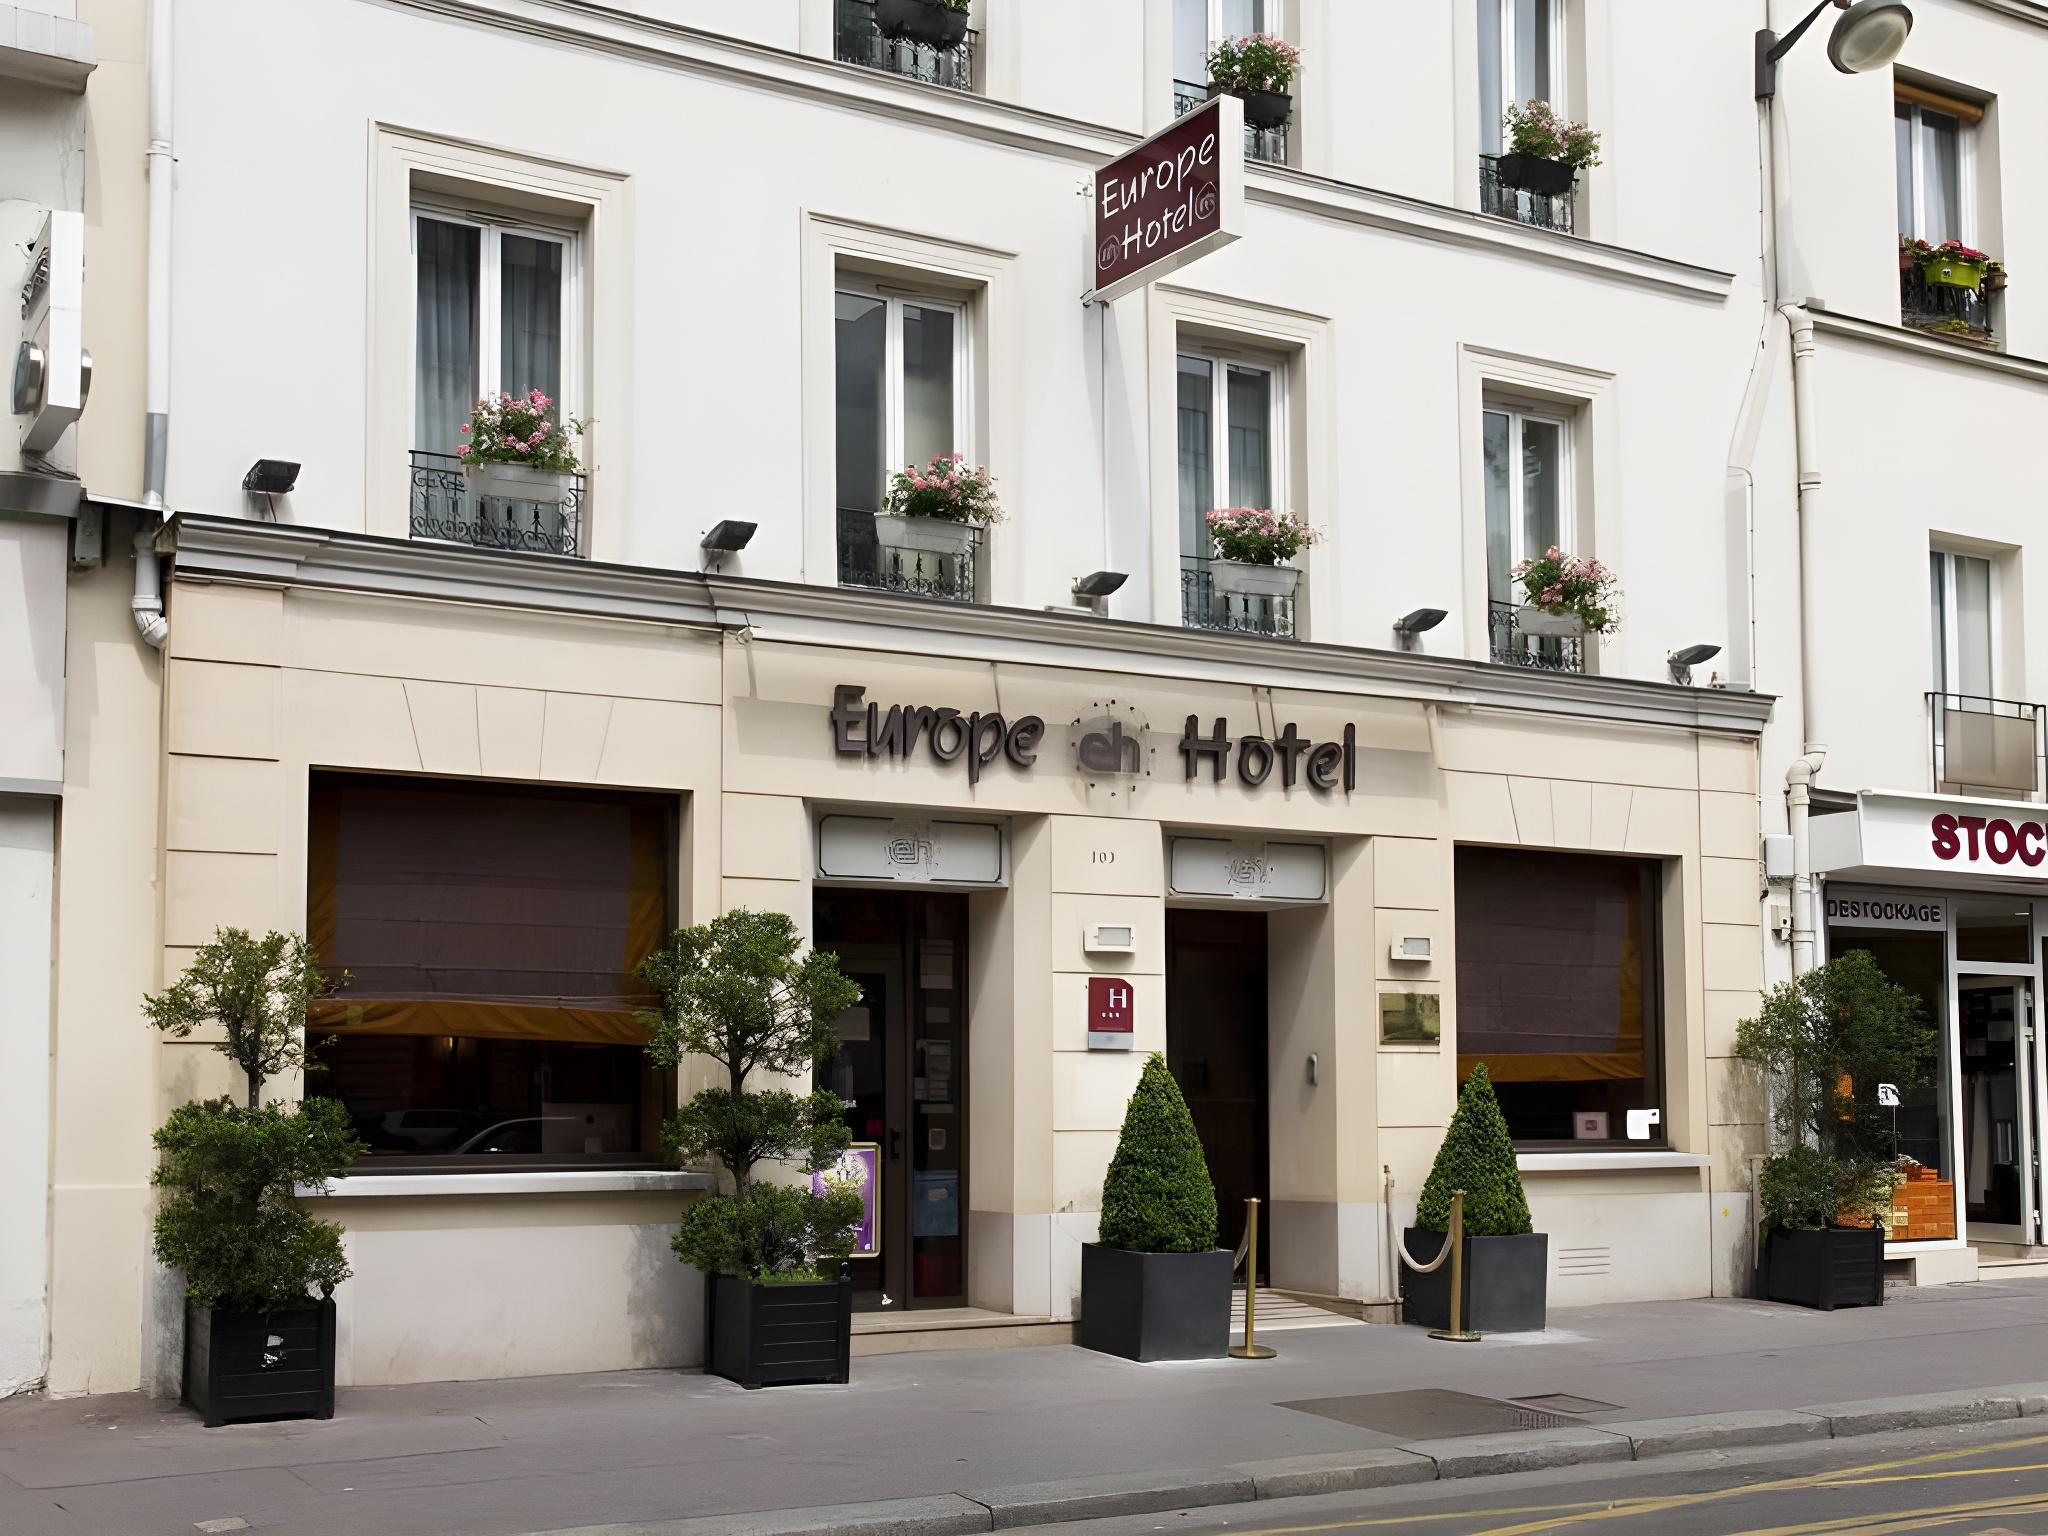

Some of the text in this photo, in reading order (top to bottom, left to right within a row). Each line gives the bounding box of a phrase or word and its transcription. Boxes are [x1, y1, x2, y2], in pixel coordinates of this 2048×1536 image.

[1102, 133, 1215, 219] Europe
[1121, 187, 1194, 260] Hotel
[831, 684, 1046, 785] Europe
[1180, 713, 1357, 792] Hotel
[1931, 813, 2048, 867] STOC
[1826, 899, 1942, 922] DESTOCKAGE
[1109, 987, 1127, 1009] H
